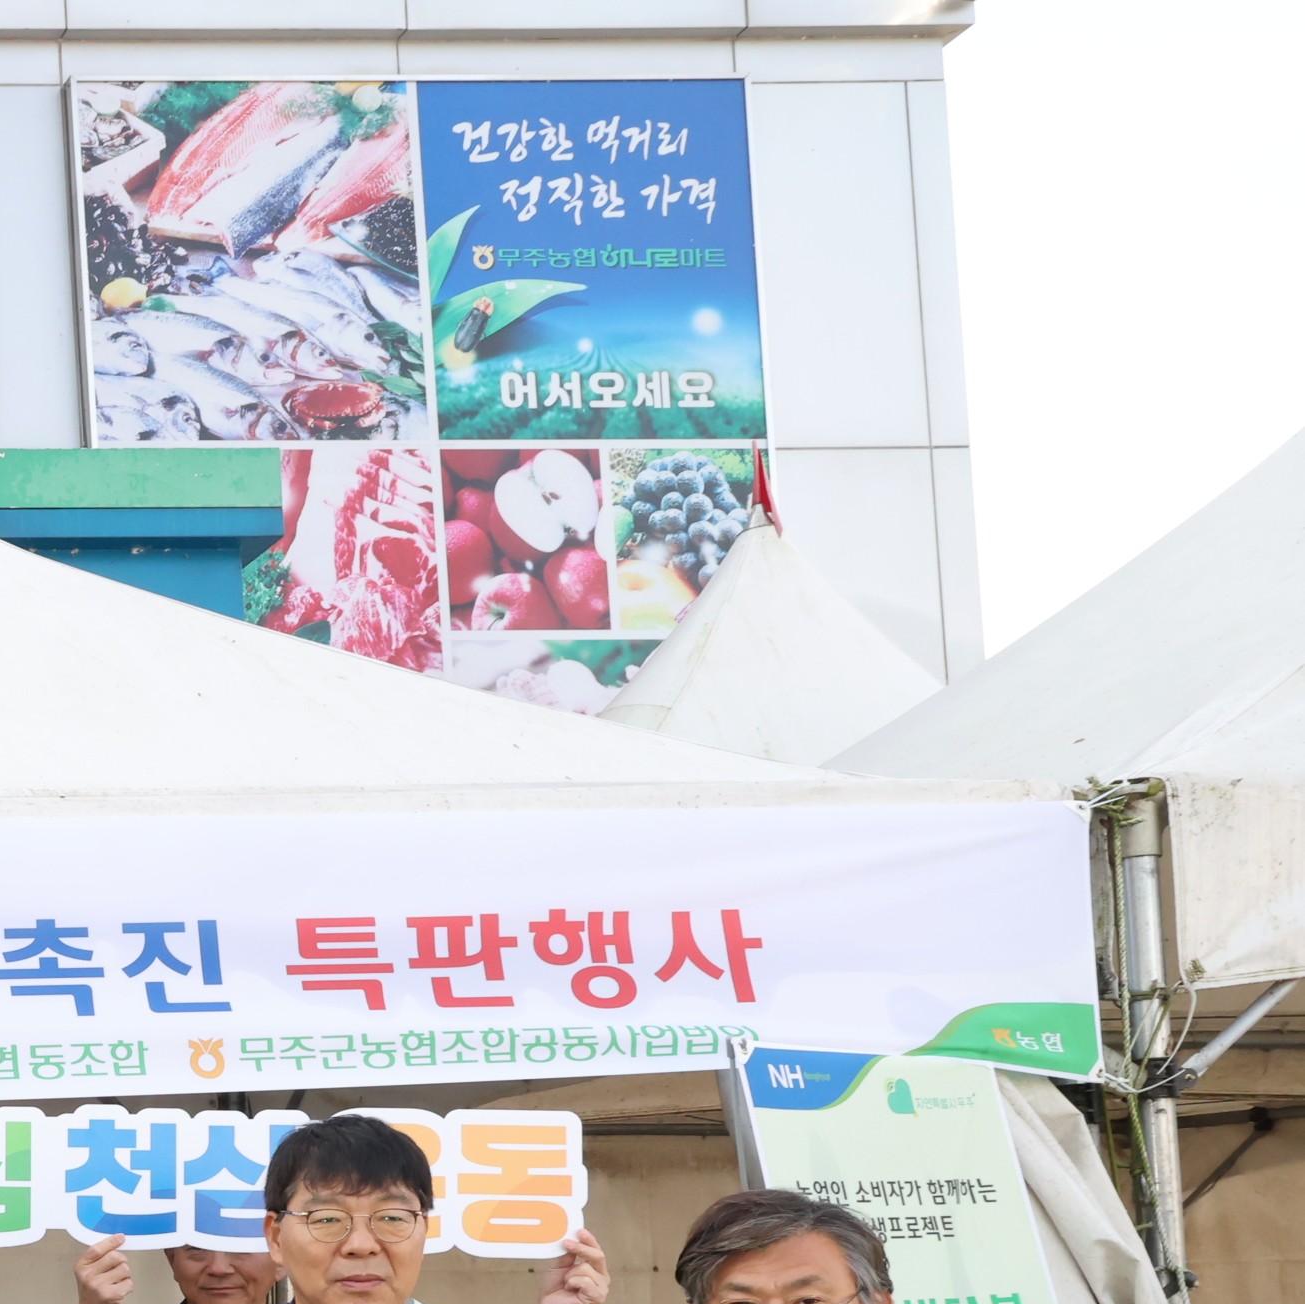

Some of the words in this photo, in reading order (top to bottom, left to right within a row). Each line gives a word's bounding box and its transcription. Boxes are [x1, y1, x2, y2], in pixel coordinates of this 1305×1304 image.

[453, 117, 575, 165] 건강한
[587, 113, 687, 165] 먹거리
[499, 173, 626, 227] 정직한
[639, 175, 717, 227] 가격
[497, 247, 597, 270] 무주농협
[601, 243, 726, 269] 하나로마트
[501, 371, 715, 411] 어서오세요
[286, 909, 763, 1011] 특판행사
[1016, 1029, 1064, 1054] 농협
[767, 1063, 805, 1089] NH
[65, 1119, 293, 1236] 천심
[856, 1181, 922, 1207] 소비자가
[926, 1178, 997, 1206] 함께하는
